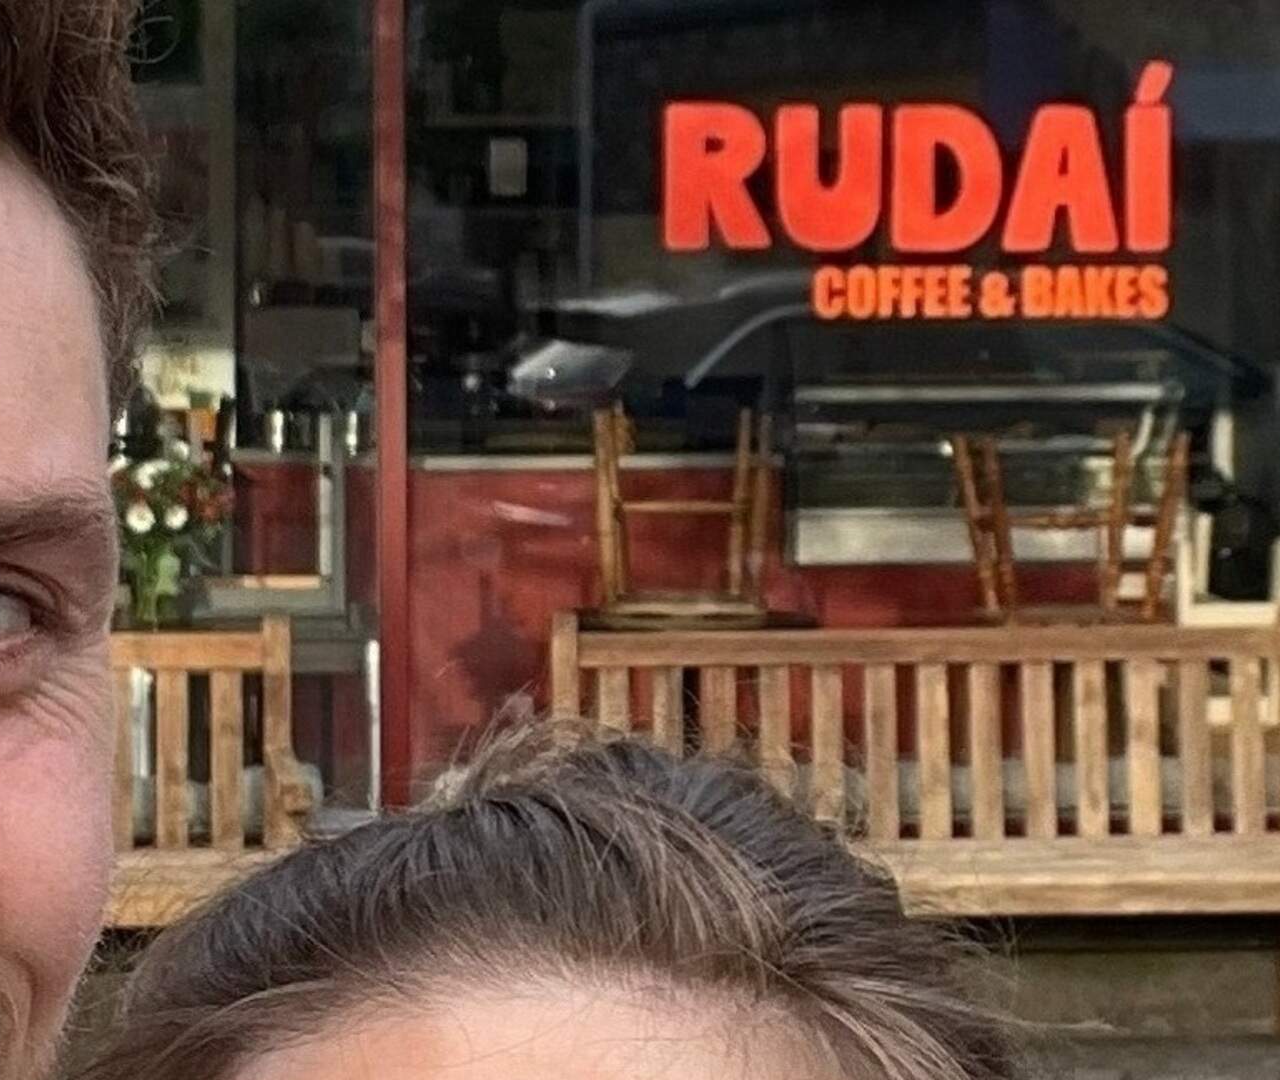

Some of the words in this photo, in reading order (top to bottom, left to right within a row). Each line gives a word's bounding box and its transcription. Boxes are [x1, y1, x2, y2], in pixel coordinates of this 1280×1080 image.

[664, 60, 1172, 252] RUDAÍ
[812, 264, 972, 319] COFFEE
[979, 271, 1016, 318] &
[1021, 265, 1169, 319] BAKES
